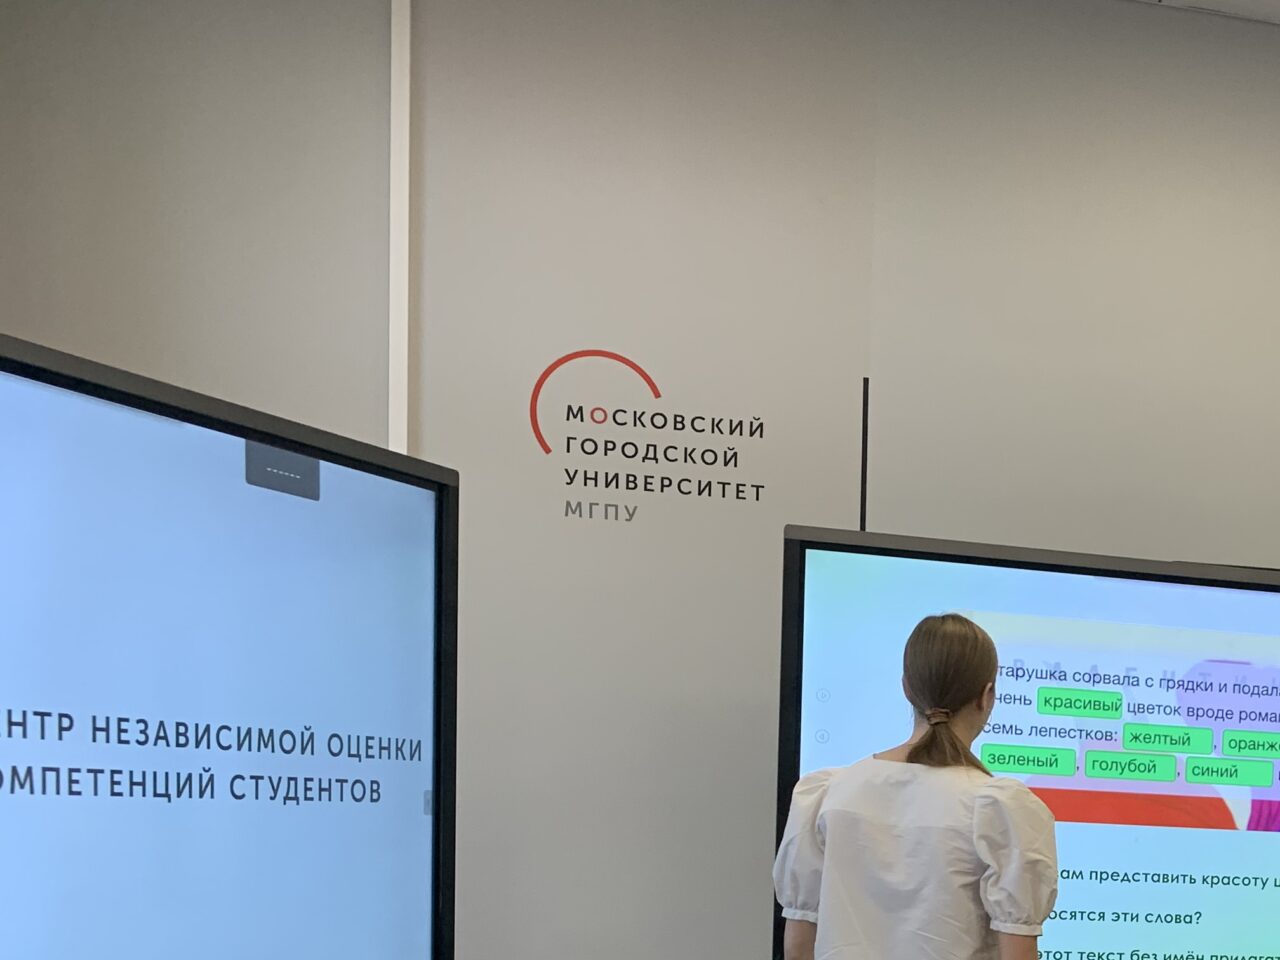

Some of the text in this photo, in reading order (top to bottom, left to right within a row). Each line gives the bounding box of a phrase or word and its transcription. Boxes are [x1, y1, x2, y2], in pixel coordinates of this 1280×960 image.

[566, 404, 764, 438] МОСКОВСКИЙ
[565, 436, 738, 468] ГОРОДСКОЙ
[564, 468, 765, 501] УНИВЕРСИТЕТ
[564, 500, 638, 522] МГПУ
[999, 664, 1067, 684] тарушка
[1072, 669, 1140, 687] сорвала
[1145, 675, 1154, 687] с
[1159, 677, 1213, 693] грядки
[1218, 682, 1228, 692] и
[995, 692, 1032, 706] чень
[1127, 702, 1181, 717] цветок
[1187, 706, 1233, 721] вроде
[0, 708, 422, 763] НТР НЕЗАВИСИМОЙ ОЦЕНКИ
[1028, 724, 1118, 742] лепестков:
[0, 765, 381, 806] МПЕТЕНЦИЙ СТУДЕНТОВ
[1057, 869, 1084, 880] ам
[1089, 870, 1197, 885] представить
[1202, 873, 1269, 890] красоту
[1048, 909, 1203, 924] осятся эти слова?
